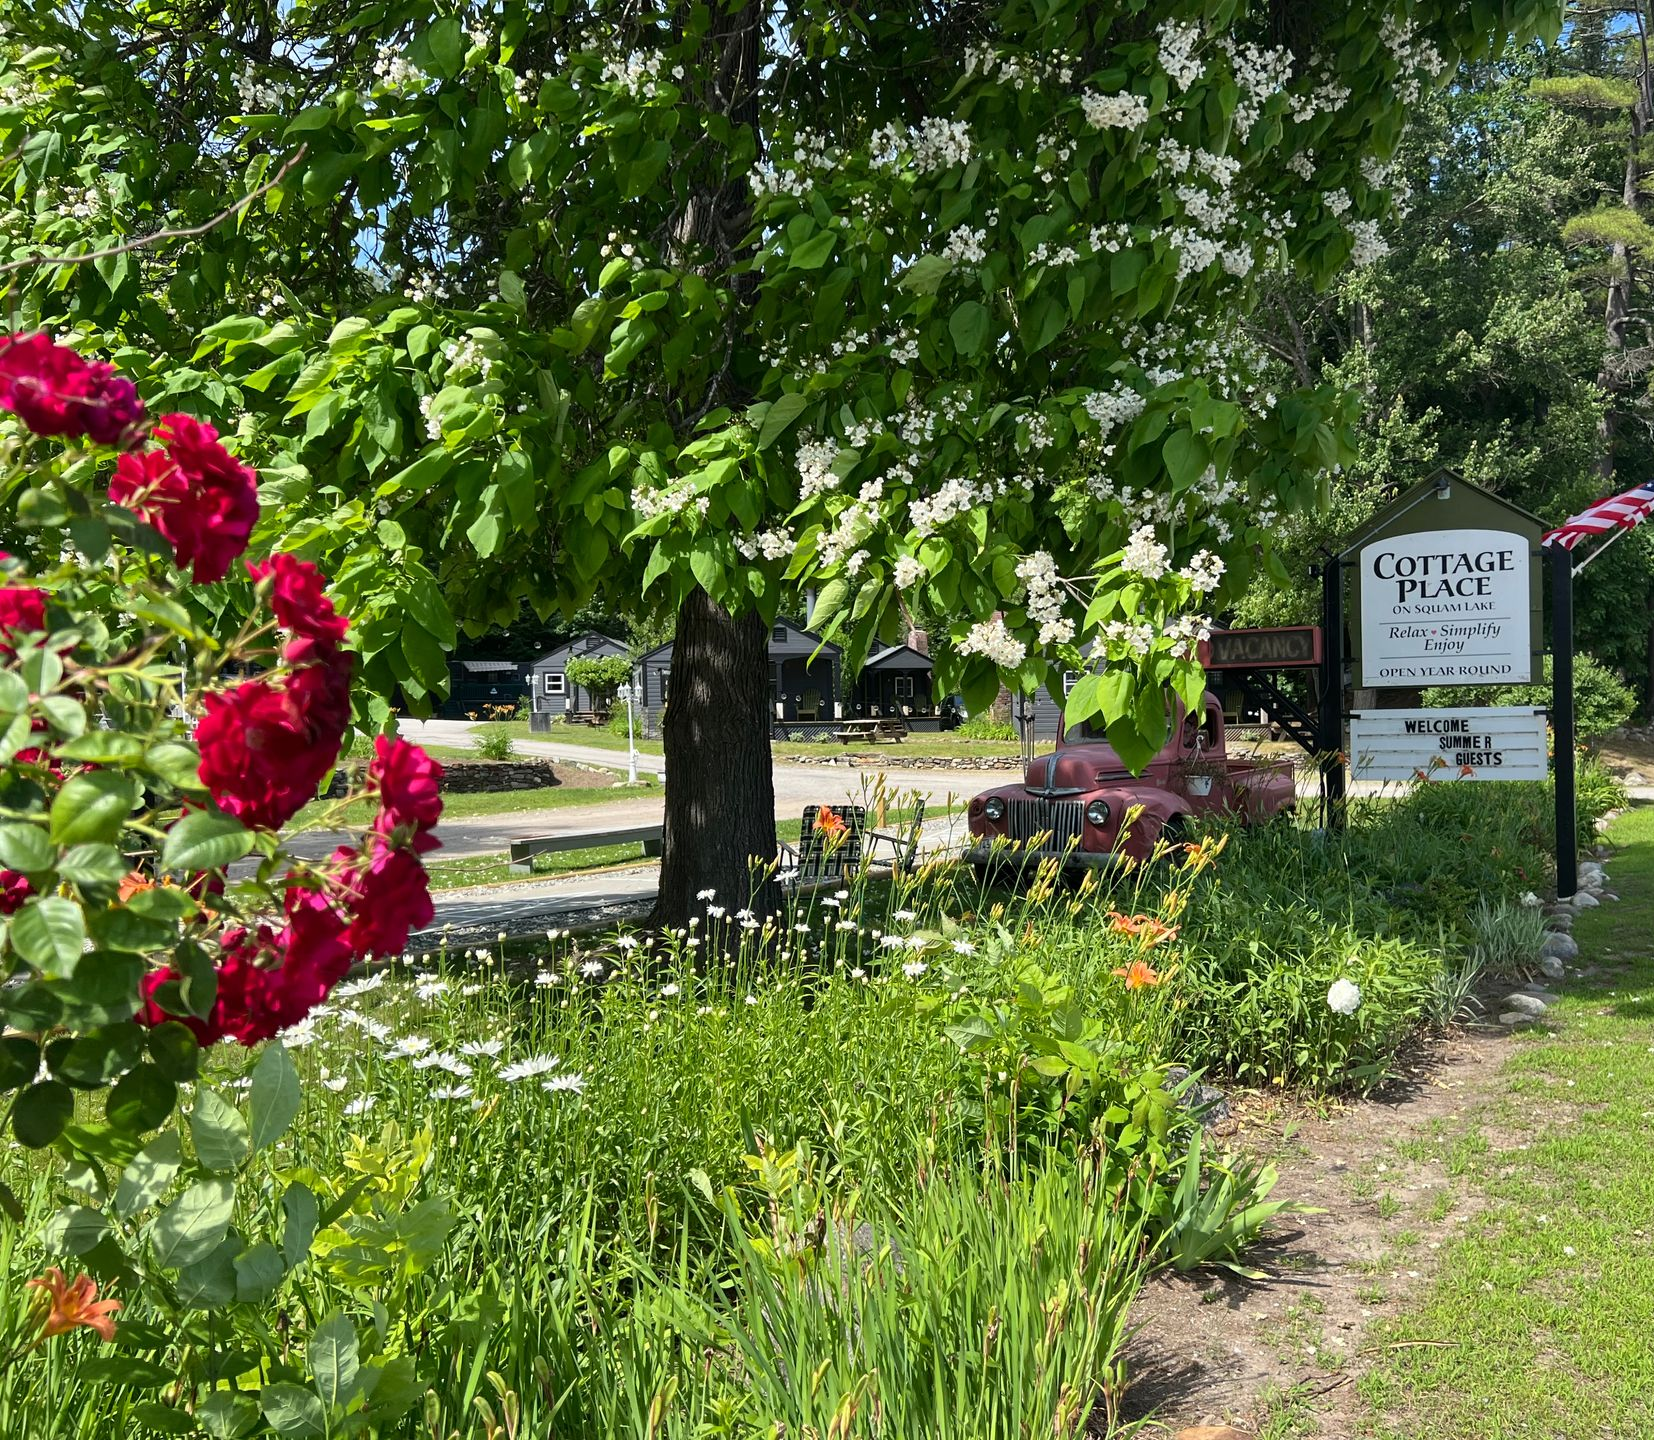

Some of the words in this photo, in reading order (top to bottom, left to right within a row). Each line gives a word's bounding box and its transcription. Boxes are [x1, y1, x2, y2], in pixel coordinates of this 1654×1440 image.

[1373, 550, 1514, 579] COTTAGE
[1395, 577, 1492, 603] PLACE
[1392, 605, 1411, 615] ON
[1415, 603, 1462, 615] SQUAM
[1465, 601, 1496, 611] LAKE
[1389, 626, 1428, 639] Relax
[1440, 622, 1501, 639] Simplify
[1218, 636, 1310, 660] VACANCY
[1424, 638, 1465, 654] Enjoy
[1379, 667, 1416, 678] OPEN
[1420, 666, 1455, 676] YEAR
[1459, 664, 1512, 675] ROUND
[1404, 719, 1469, 733] WELCOME
[1439, 736, 1492, 750] SUMMER
[1455, 752, 1503, 766] GUESTS
